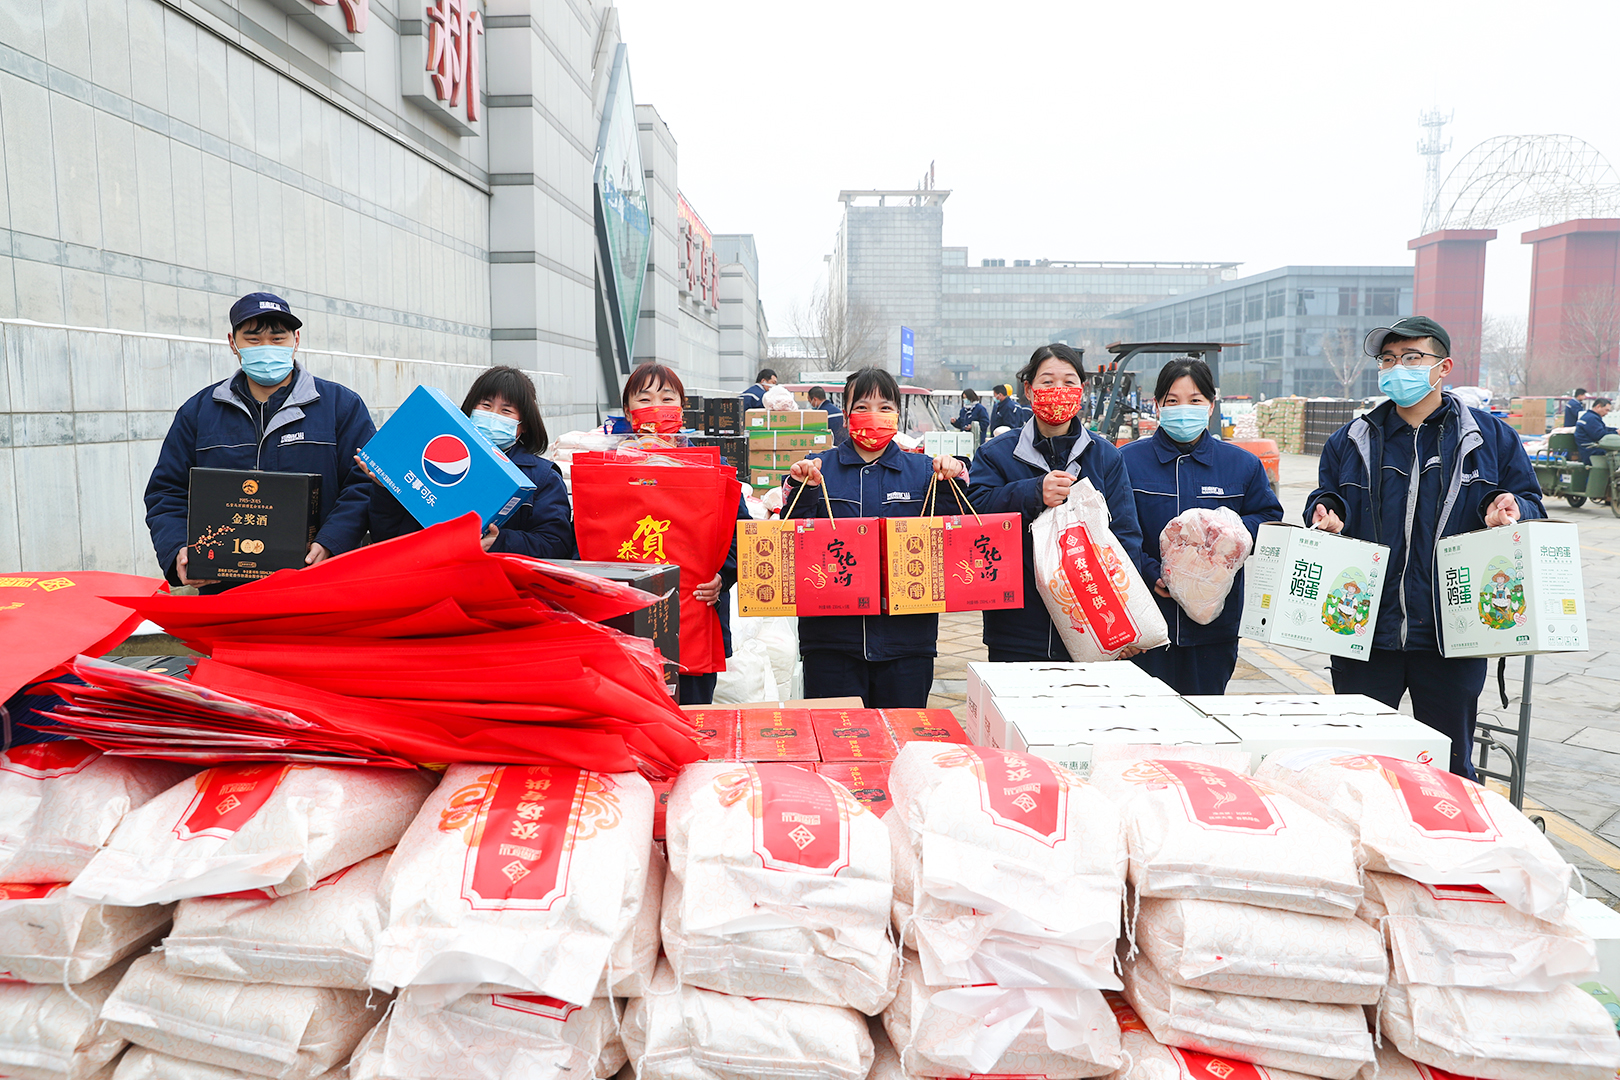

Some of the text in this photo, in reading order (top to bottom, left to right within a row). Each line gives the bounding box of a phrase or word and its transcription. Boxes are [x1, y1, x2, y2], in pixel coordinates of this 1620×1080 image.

[404, 470, 438, 507] 百事可乐
[232, 512, 268, 526] 金奖酒
[758, 540, 773, 600] 风味醋
[828, 538, 857, 586] 宁化府
[908, 538, 923, 598] 风味醋
[974, 534, 1002, 582] 宁化府
[1074, 557, 1106, 610] 农场专供
[510, 778, 552, 840] 农场专供
